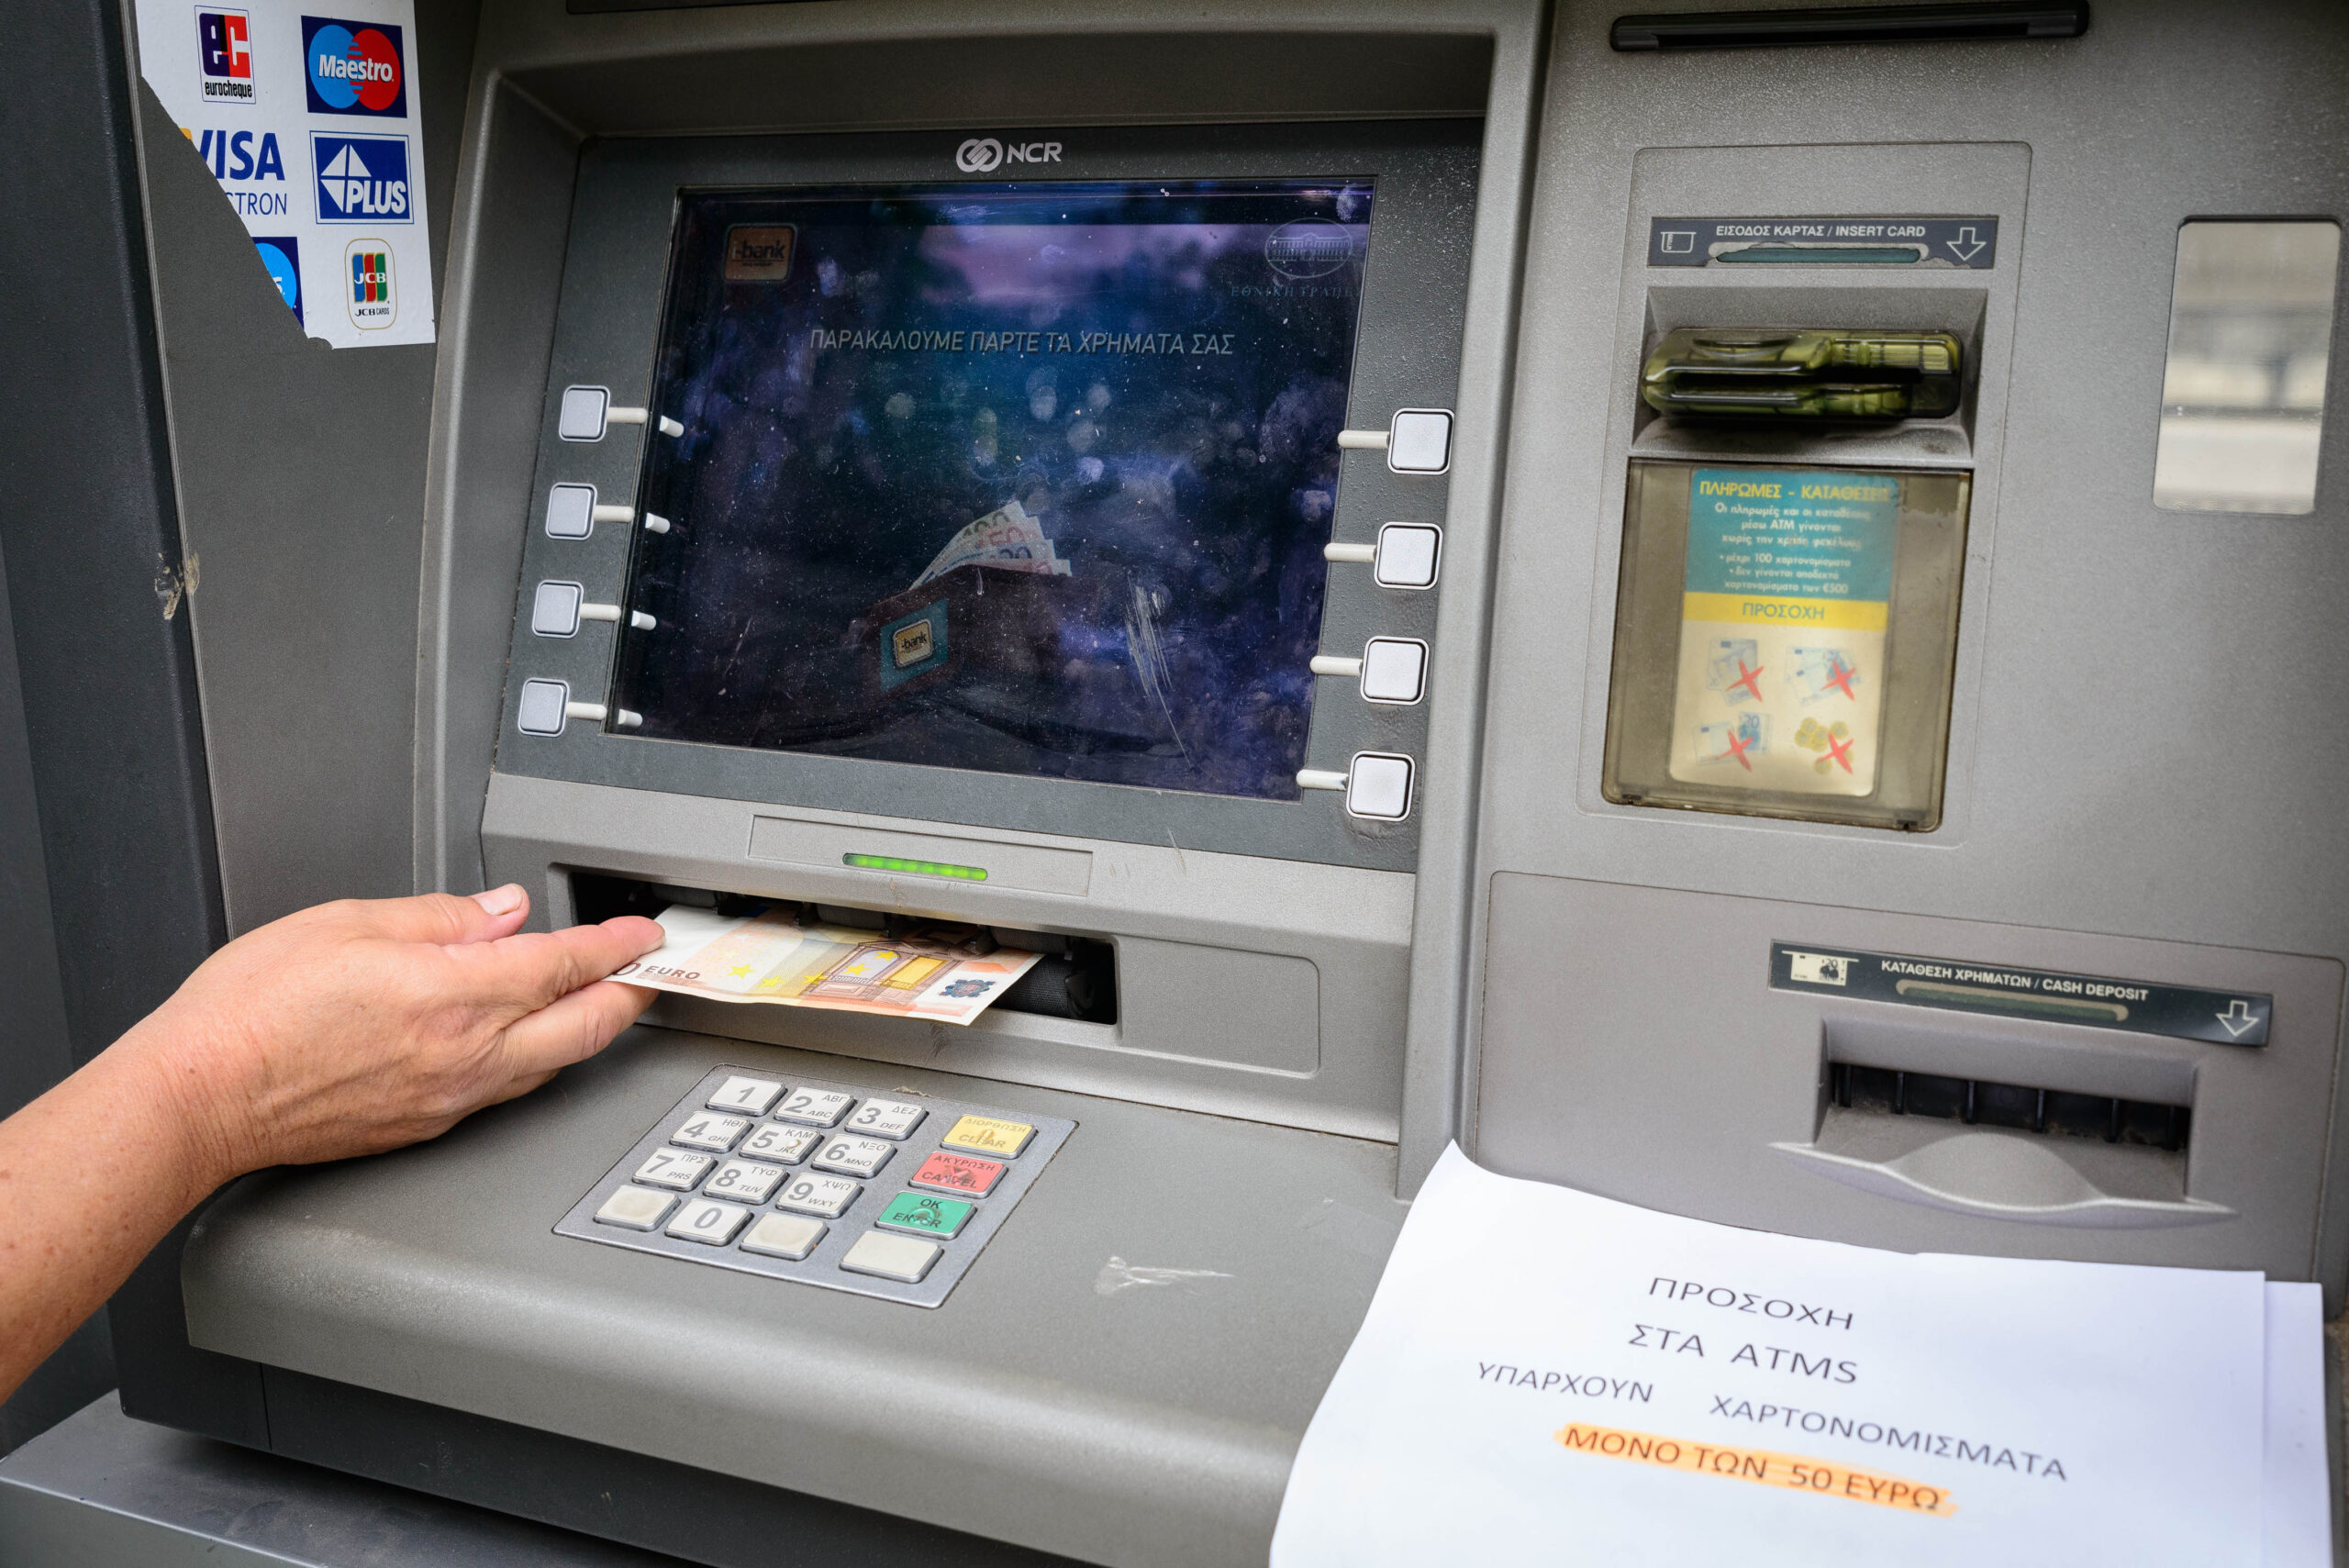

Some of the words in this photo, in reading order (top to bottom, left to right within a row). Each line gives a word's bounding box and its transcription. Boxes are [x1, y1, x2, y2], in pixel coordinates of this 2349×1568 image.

[318, 54, 394, 82] Maestro
[205, 80, 252, 98] eurocheque
[1007, 142, 1063, 163] NCR
[226, 192, 287, 215] TRON
[346, 180, 406, 214] PLUS
[1716, 226, 1771, 237] ΕΙΣΟΔΟΣ
[1774, 226, 1825, 237] ΚΑΡΤΑΣ
[1836, 226, 1885, 237] INSERT
[1887, 226, 1926, 237] CARD
[354, 272, 386, 284] JCB
[355, 308, 375, 317] JCB
[810, 329, 965, 350] ΠΑΡΑΚΑΛΟΥΜΕ
[970, 331, 1041, 352] ΠΑΡΤΕ
[1046, 332, 1072, 353] ΤΑ
[1076, 333, 1184, 354] ΧΡΗΜΑΤΑ
[1191, 334, 1235, 355] ΣΑΣ
[1699, 481, 1782, 498] ΠΛΗΡΩΜΕΣ
[1742, 602, 1825, 620] ΠΡΟΣΟΧΗ
[644, 965, 701, 980] EURO
[1881, 960, 1952, 979] ΚΑΤΑΘΕΣΗ
[1955, 969, 2032, 989] ΧΡΗΜΑΤΩΝ
[2043, 979, 2083, 995] CASH
[2086, 986, 2149, 1001] DEPOSIT
[737, 1086, 755, 1104] 1
[784, 1095, 813, 1114] 2
[856, 1107, 882, 1125] 3
[684, 1120, 710, 1139] 4
[879, 1122, 905, 1131] DEF
[708, 1135, 729, 1143] GHI
[751, 1129, 780, 1149] 5
[825, 1143, 851, 1162] 6
[645, 1154, 675, 1174] 7
[933, 1155, 996, 1171] ΑΚΥΡΩΣΗ
[667, 1171, 691, 1180] PRS
[715, 1168, 741, 1187] 8
[739, 1184, 763, 1194] TUV
[788, 1182, 814, 1201] 9
[808, 1197, 837, 1207] WXY
[919, 1198, 943, 1209] OK
[694, 1207, 723, 1229] 0
[1649, 1277, 1854, 1330] ΠΡΟΣΟΧΗ
[1628, 1324, 1706, 1358] ΣΤΑ
[1476, 1362, 1653, 1404] ΥΠΑΡΧΟΥΝ
[1709, 1395, 2069, 1483] ΧΑΡΤΟΝΟΜΙΣΜΑΤΑ
[1564, 1427, 1680, 1464] ΜΟΝΟ
[1694, 1447, 1767, 1480] ΤΩΝ
[1787, 1464, 1834, 1491] 50
[1843, 1473, 1940, 1512] ΕΥΡΩ
